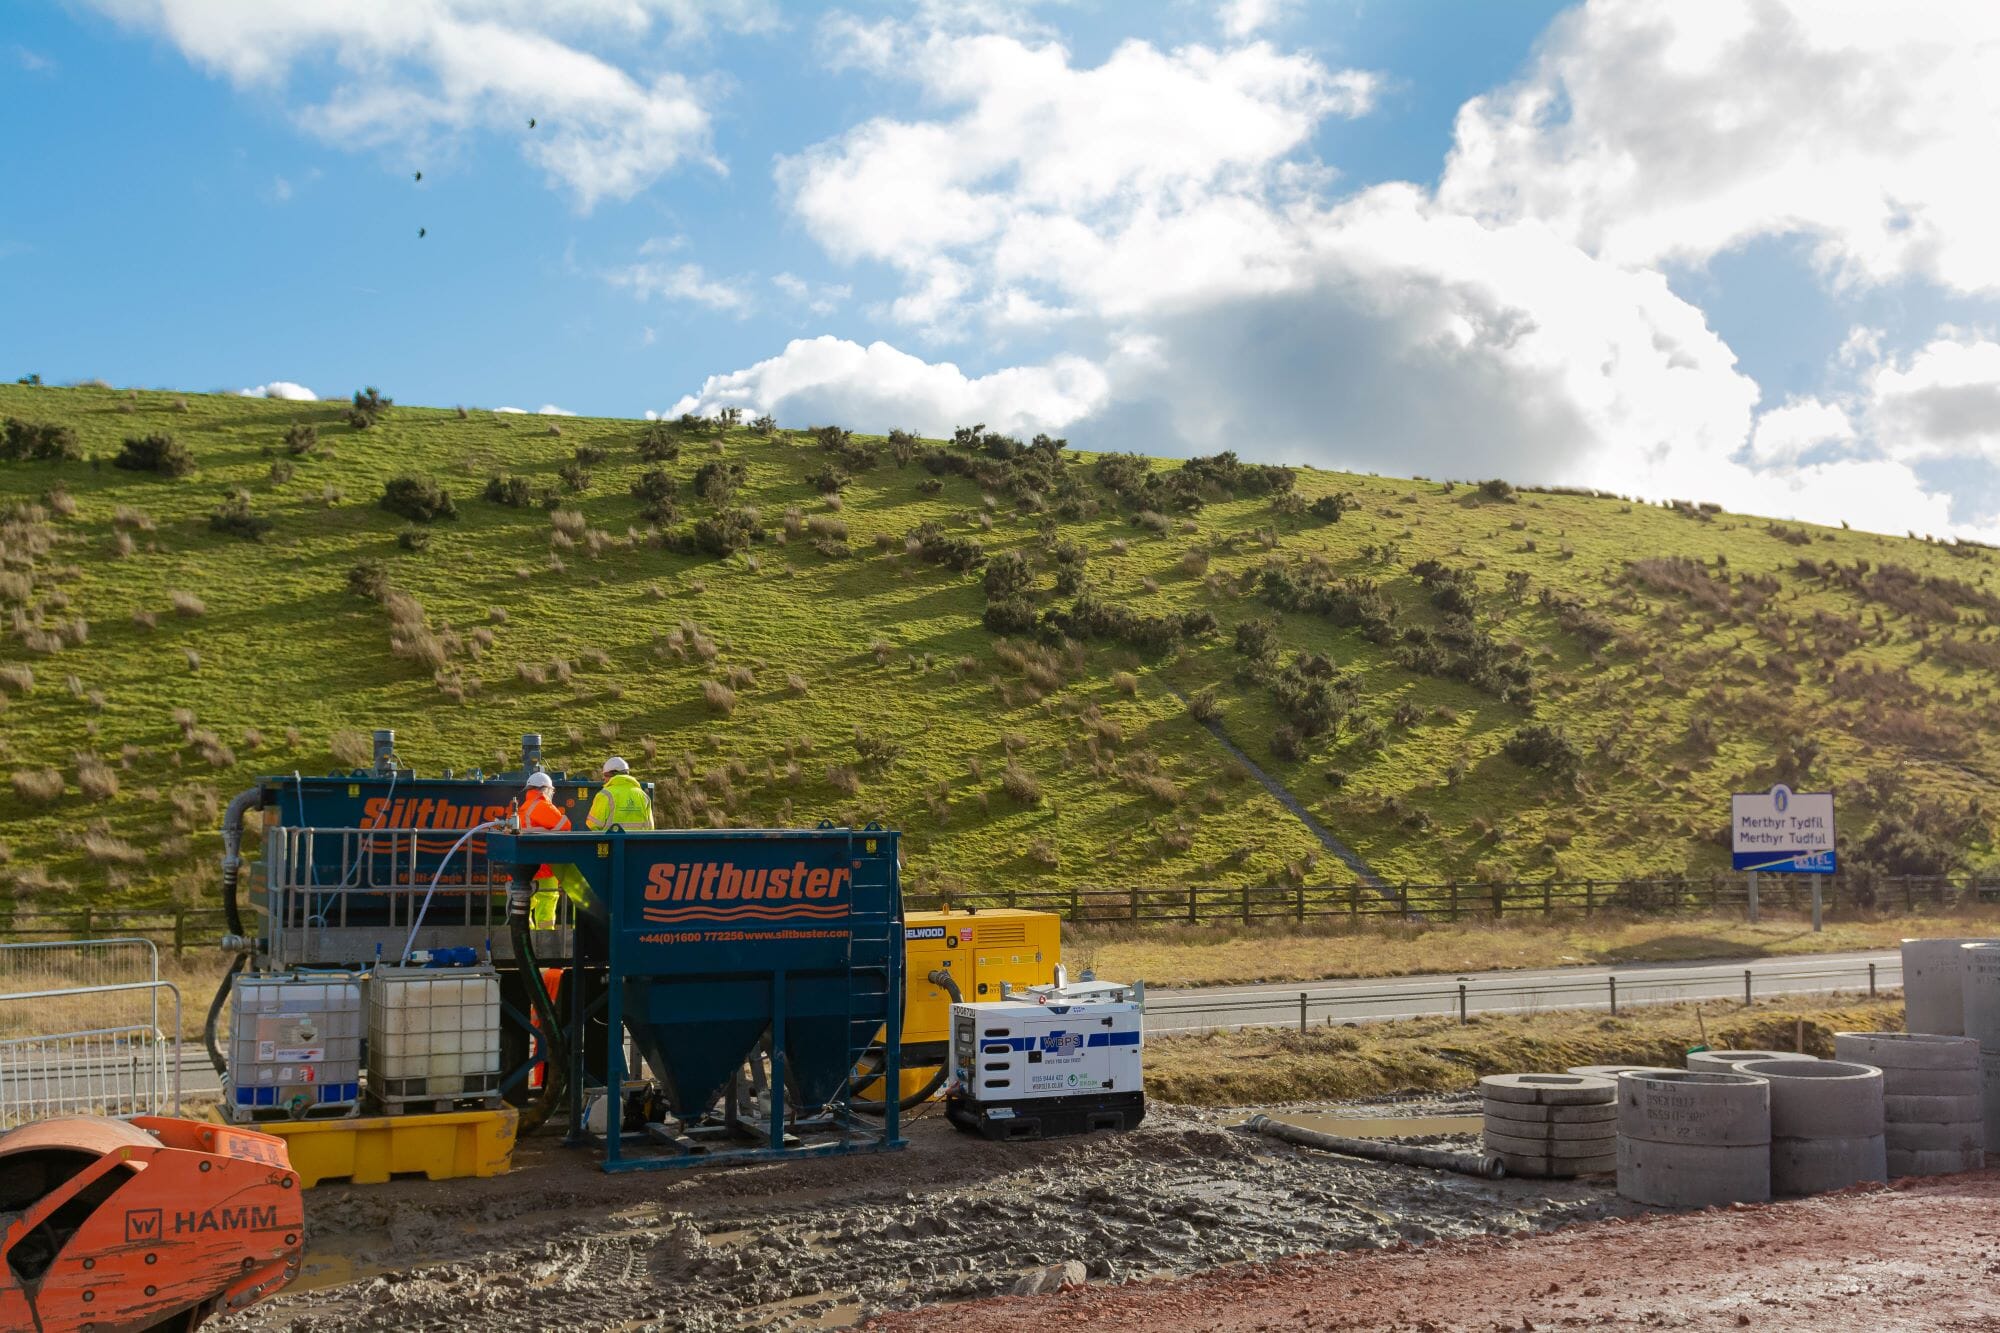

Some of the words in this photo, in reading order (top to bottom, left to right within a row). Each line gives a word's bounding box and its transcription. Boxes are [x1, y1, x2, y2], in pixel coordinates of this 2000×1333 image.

[1741, 816, 1785, 830] Merthyr
[1790, 816, 1824, 830] Tydfil
[1740, 832, 1784, 846] Merthyr
[1788, 832, 1827, 845] Tudful
[644, 861, 850, 901] Siltbuster
[639, 932, 701, 944] +44(0)1600
[704, 931, 743, 942] 772256
[1043, 1036, 1080, 1048] WBPS
[175, 1205, 277, 1234] HAMM
